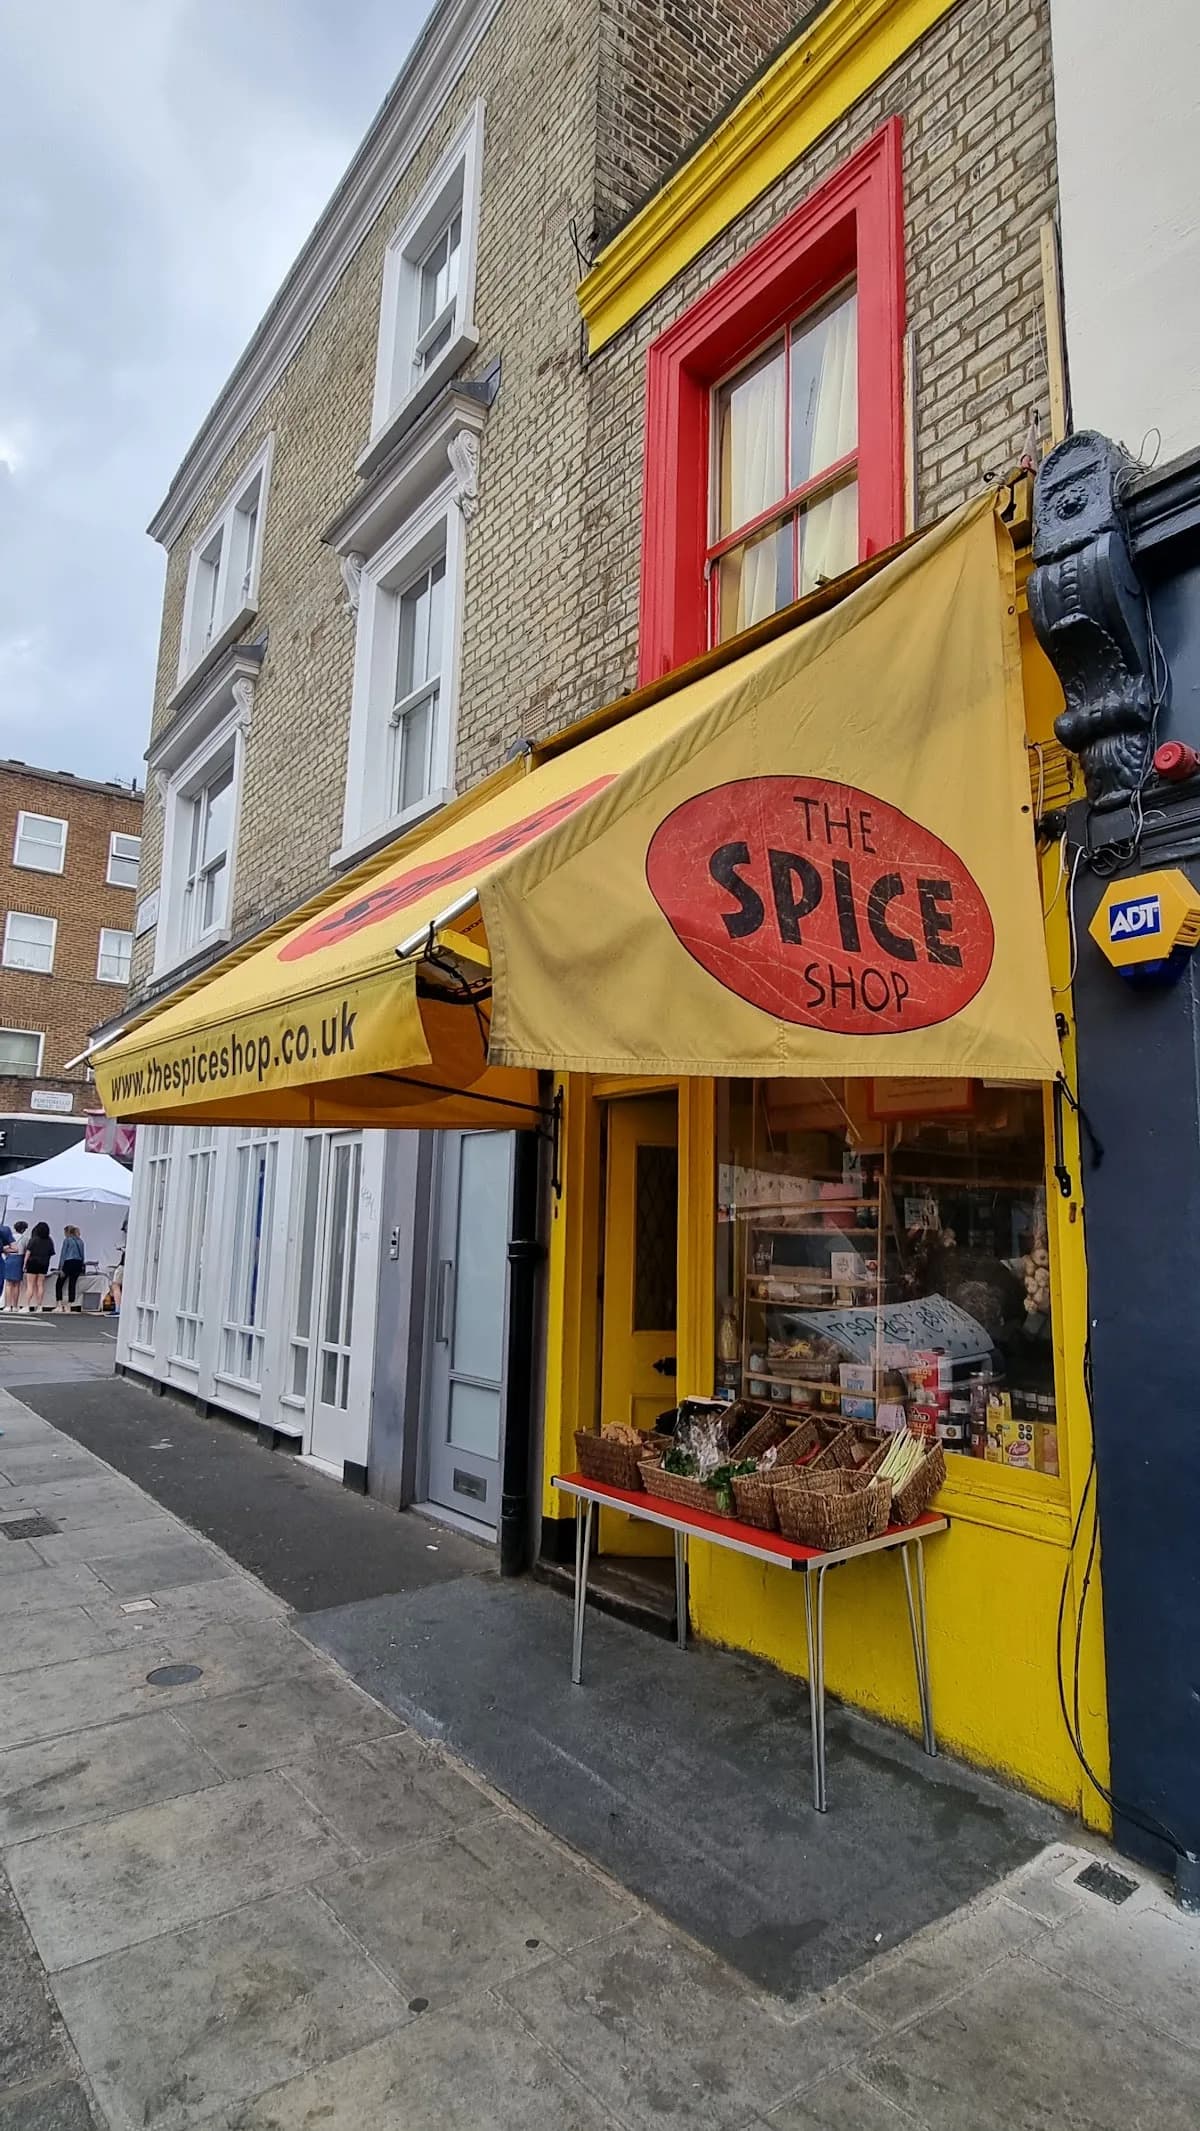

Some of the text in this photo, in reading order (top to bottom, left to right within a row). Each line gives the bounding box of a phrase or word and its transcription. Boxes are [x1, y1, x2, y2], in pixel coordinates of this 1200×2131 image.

[793, 796, 876, 854] THE
[708, 841, 963, 968] SPICE
[1110, 901, 1159, 936] ADT
[804, 962, 909, 1013] SHOP
[111, 1001, 358, 1102] www.thespiceshop.co.uk
